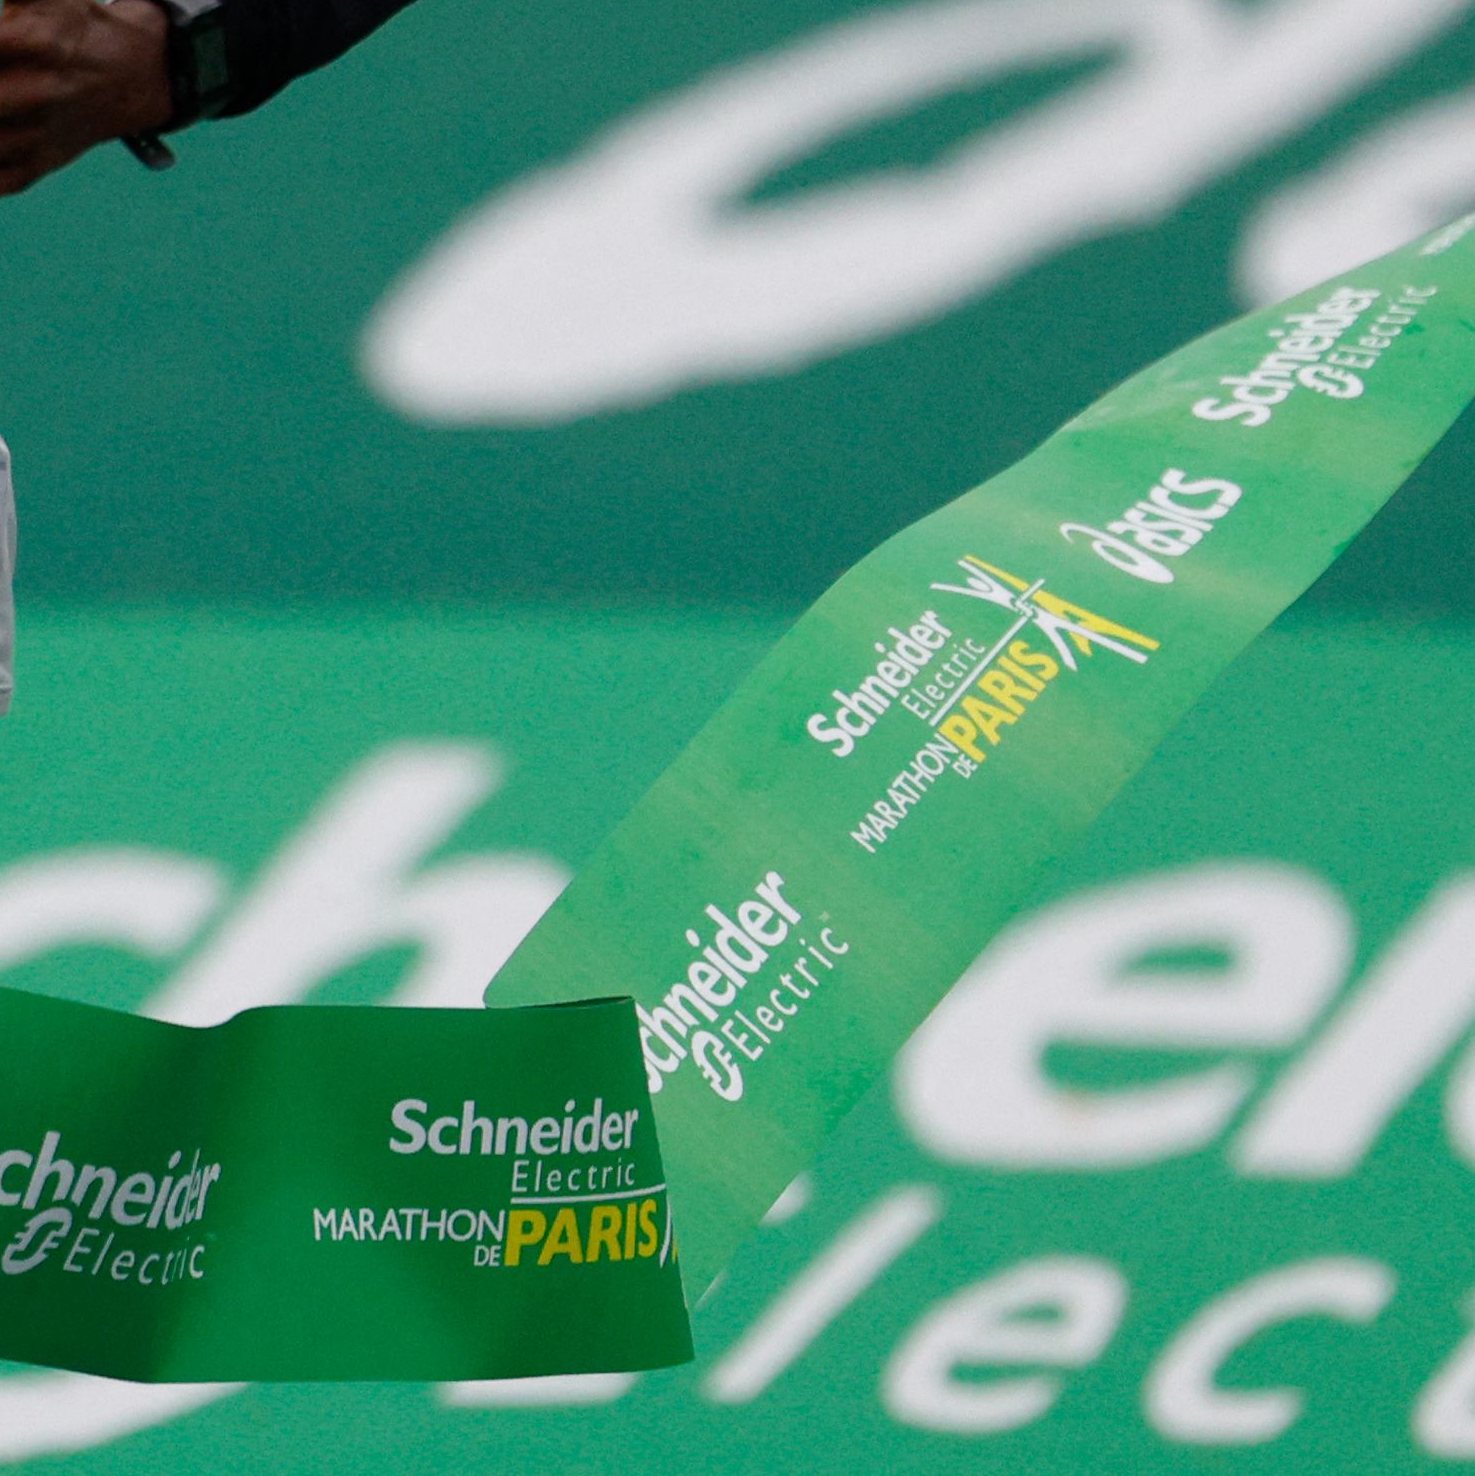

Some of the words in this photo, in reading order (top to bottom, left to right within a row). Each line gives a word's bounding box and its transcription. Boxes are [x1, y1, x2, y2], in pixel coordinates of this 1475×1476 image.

[1192, 286, 1381, 427] Schneider
[1328, 285, 1438, 370] Electric
[1105, 467, 1243, 557] asics
[806, 609, 953, 758] Schneider
[900, 634, 986, 721] Electric
[936, 638, 1061, 764] PARIS
[849, 732, 959, 853] MARATHON
[951, 751, 979, 779] DE
[720, 927, 849, 1062] Electric
[388, 1098, 638, 1156] Schneider
[511, 1158, 636, 1193] Electric
[62, 1227, 206, 1286] Electric
[312, 1207, 506, 1243] MARATHON
[473, 1245, 501, 1268] DE
[503, 1198, 659, 1267] PARIS
